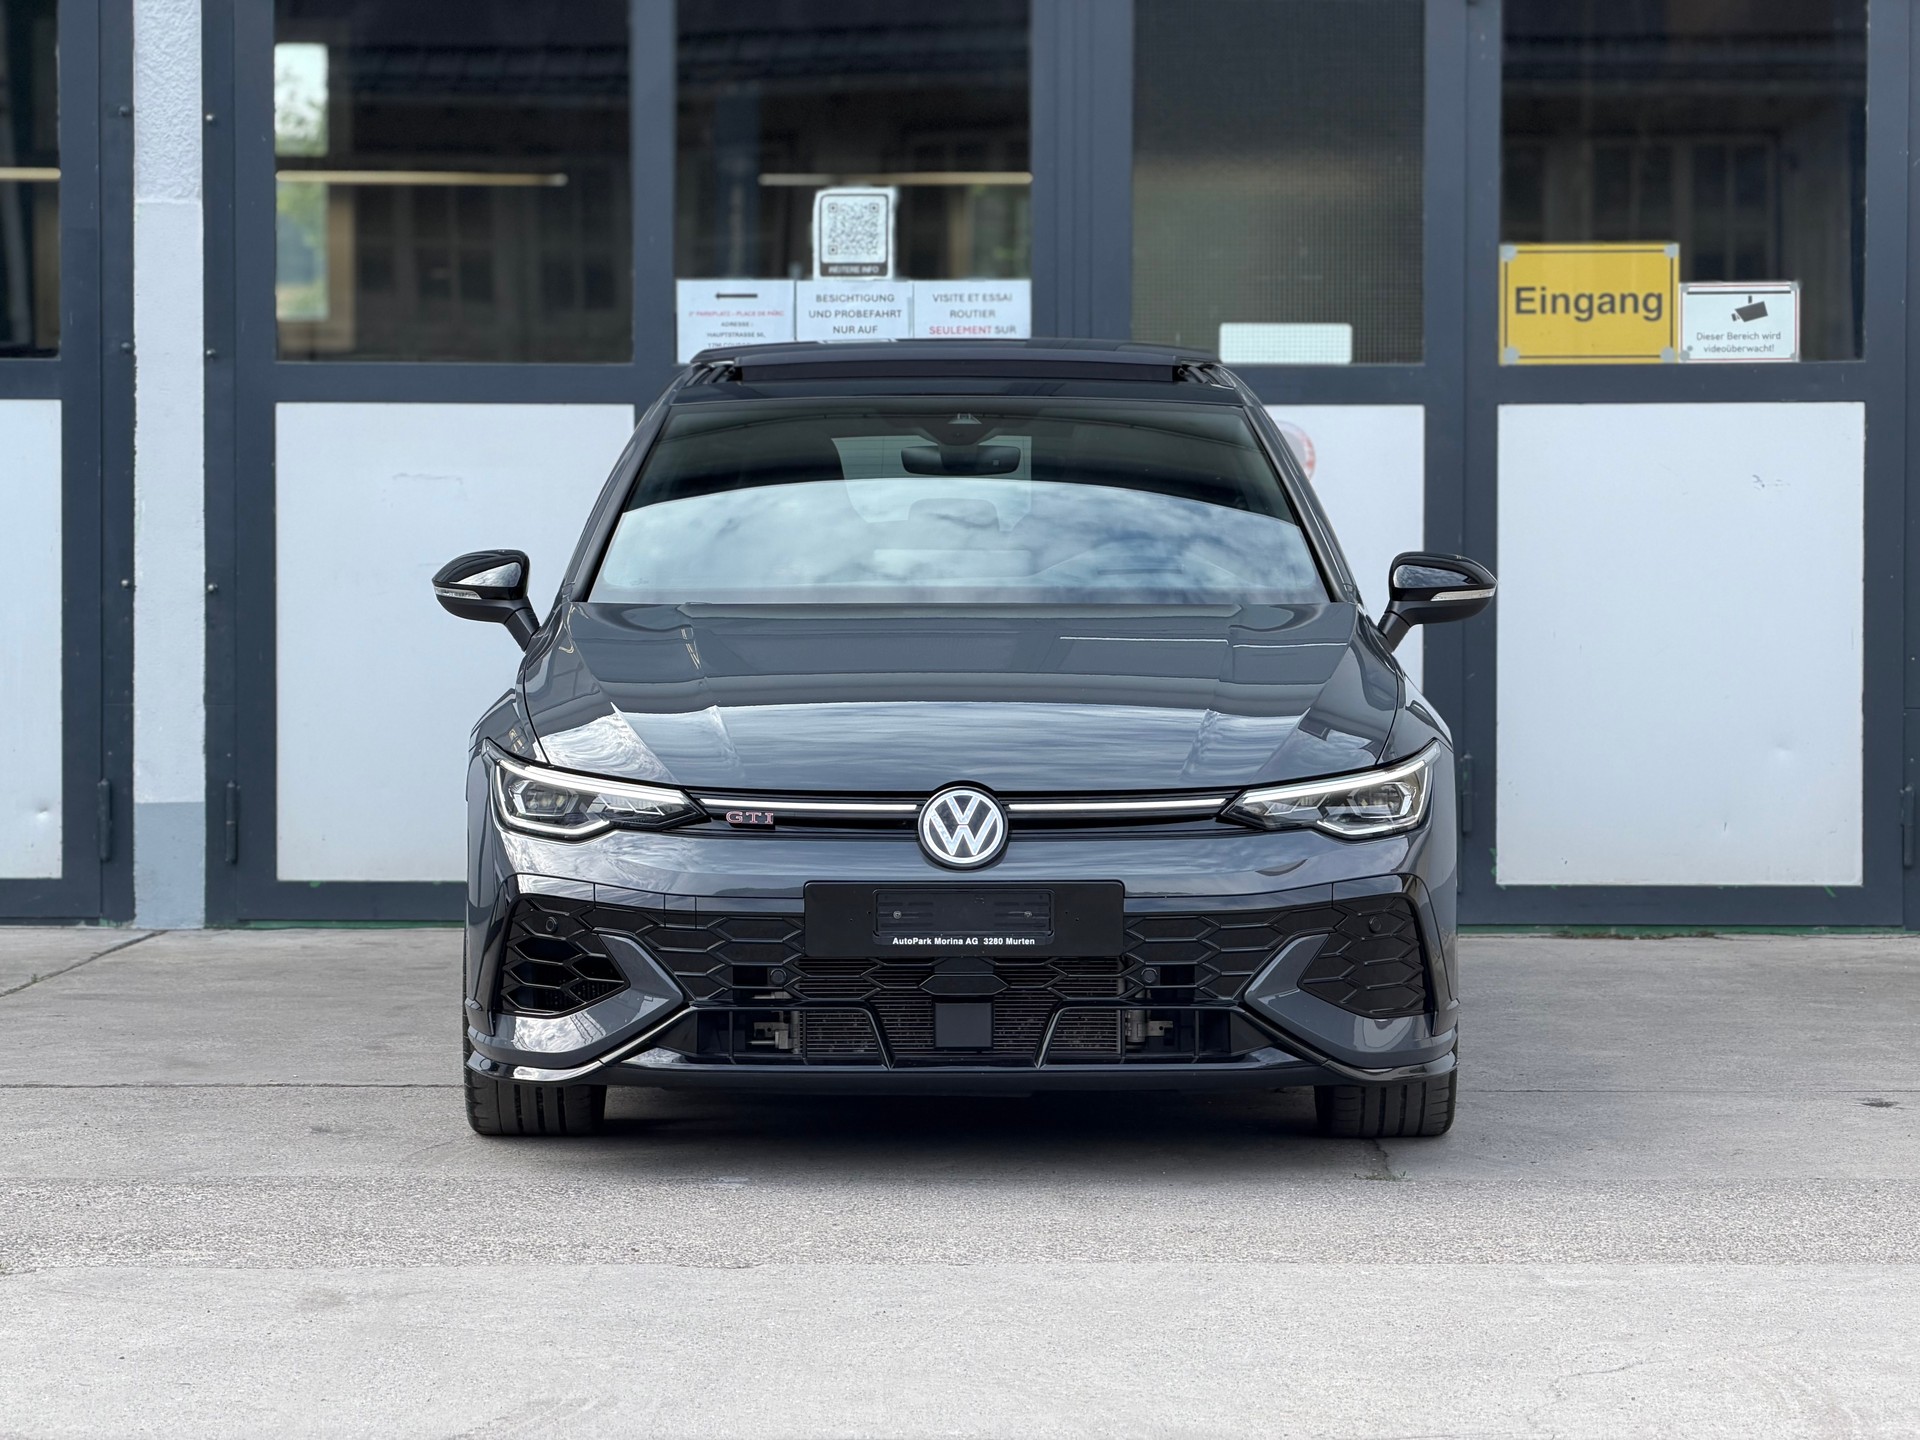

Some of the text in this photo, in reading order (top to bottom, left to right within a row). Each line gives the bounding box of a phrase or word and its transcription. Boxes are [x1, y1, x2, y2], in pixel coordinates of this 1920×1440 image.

[816, 293, 895, 303] BESICHTIGUNG
[932, 293, 1013, 303] VISITE ET ESSAI
[1514, 286, 1663, 322] Eingang
[808, 309, 902, 319] UND PROBEFAHRT
[950, 309, 996, 319] ROUTIER
[833, 325, 878, 334] NUR AUF
[929, 325, 1017, 335] SEULEMENT SUR
[1696, 331, 1781, 341] Dieser Bereich wird
[1703, 344, 1775, 353] videoüberwacht!
[725, 810, 774, 825] GTI
[892, 937, 1035, 945] AutoPark Morina AG 3280 Murten
